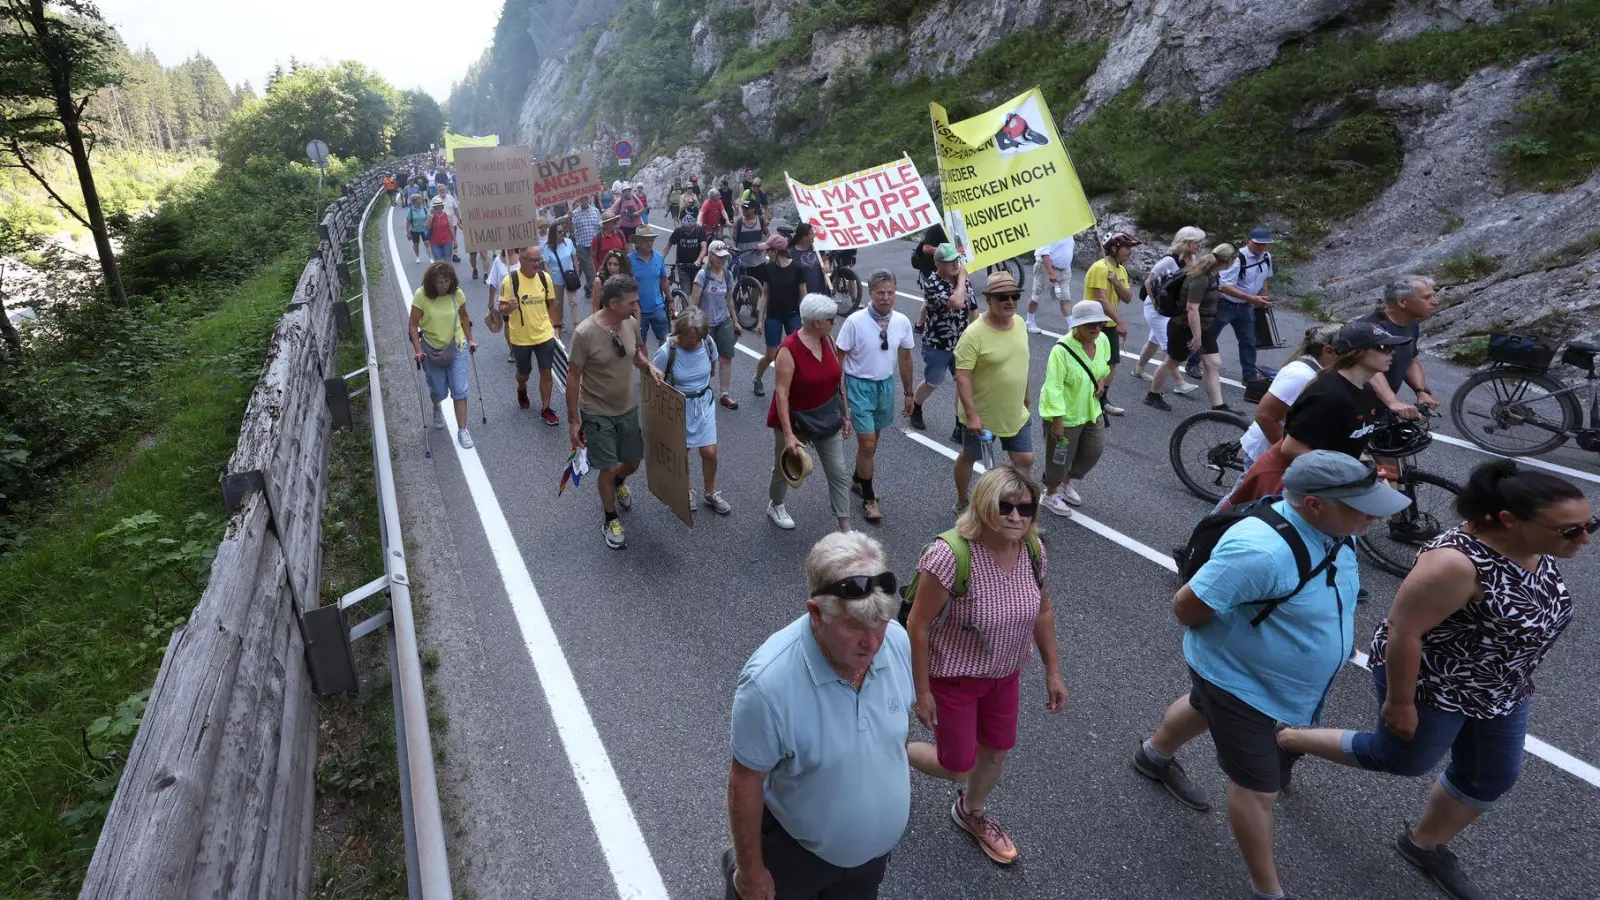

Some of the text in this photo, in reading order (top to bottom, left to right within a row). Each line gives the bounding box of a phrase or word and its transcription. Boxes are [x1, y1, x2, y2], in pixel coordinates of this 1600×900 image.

[537, 154, 581, 177] ÖVP
[1011, 161, 1057, 187] NOCH
[504, 178, 531, 195] NICHT!
[533, 167, 589, 195] ANGST
[792, 184, 821, 208] LH.
[821, 163, 919, 207] MATTLE
[504, 204, 524, 219] EURE
[818, 185, 920, 228] STOPP
[964, 193, 1041, 230] AUSWEICH-
[508, 217, 537, 241] NICHT!
[829, 202, 931, 247] DIE MAUT
[972, 222, 1031, 254] ROUTEN!
